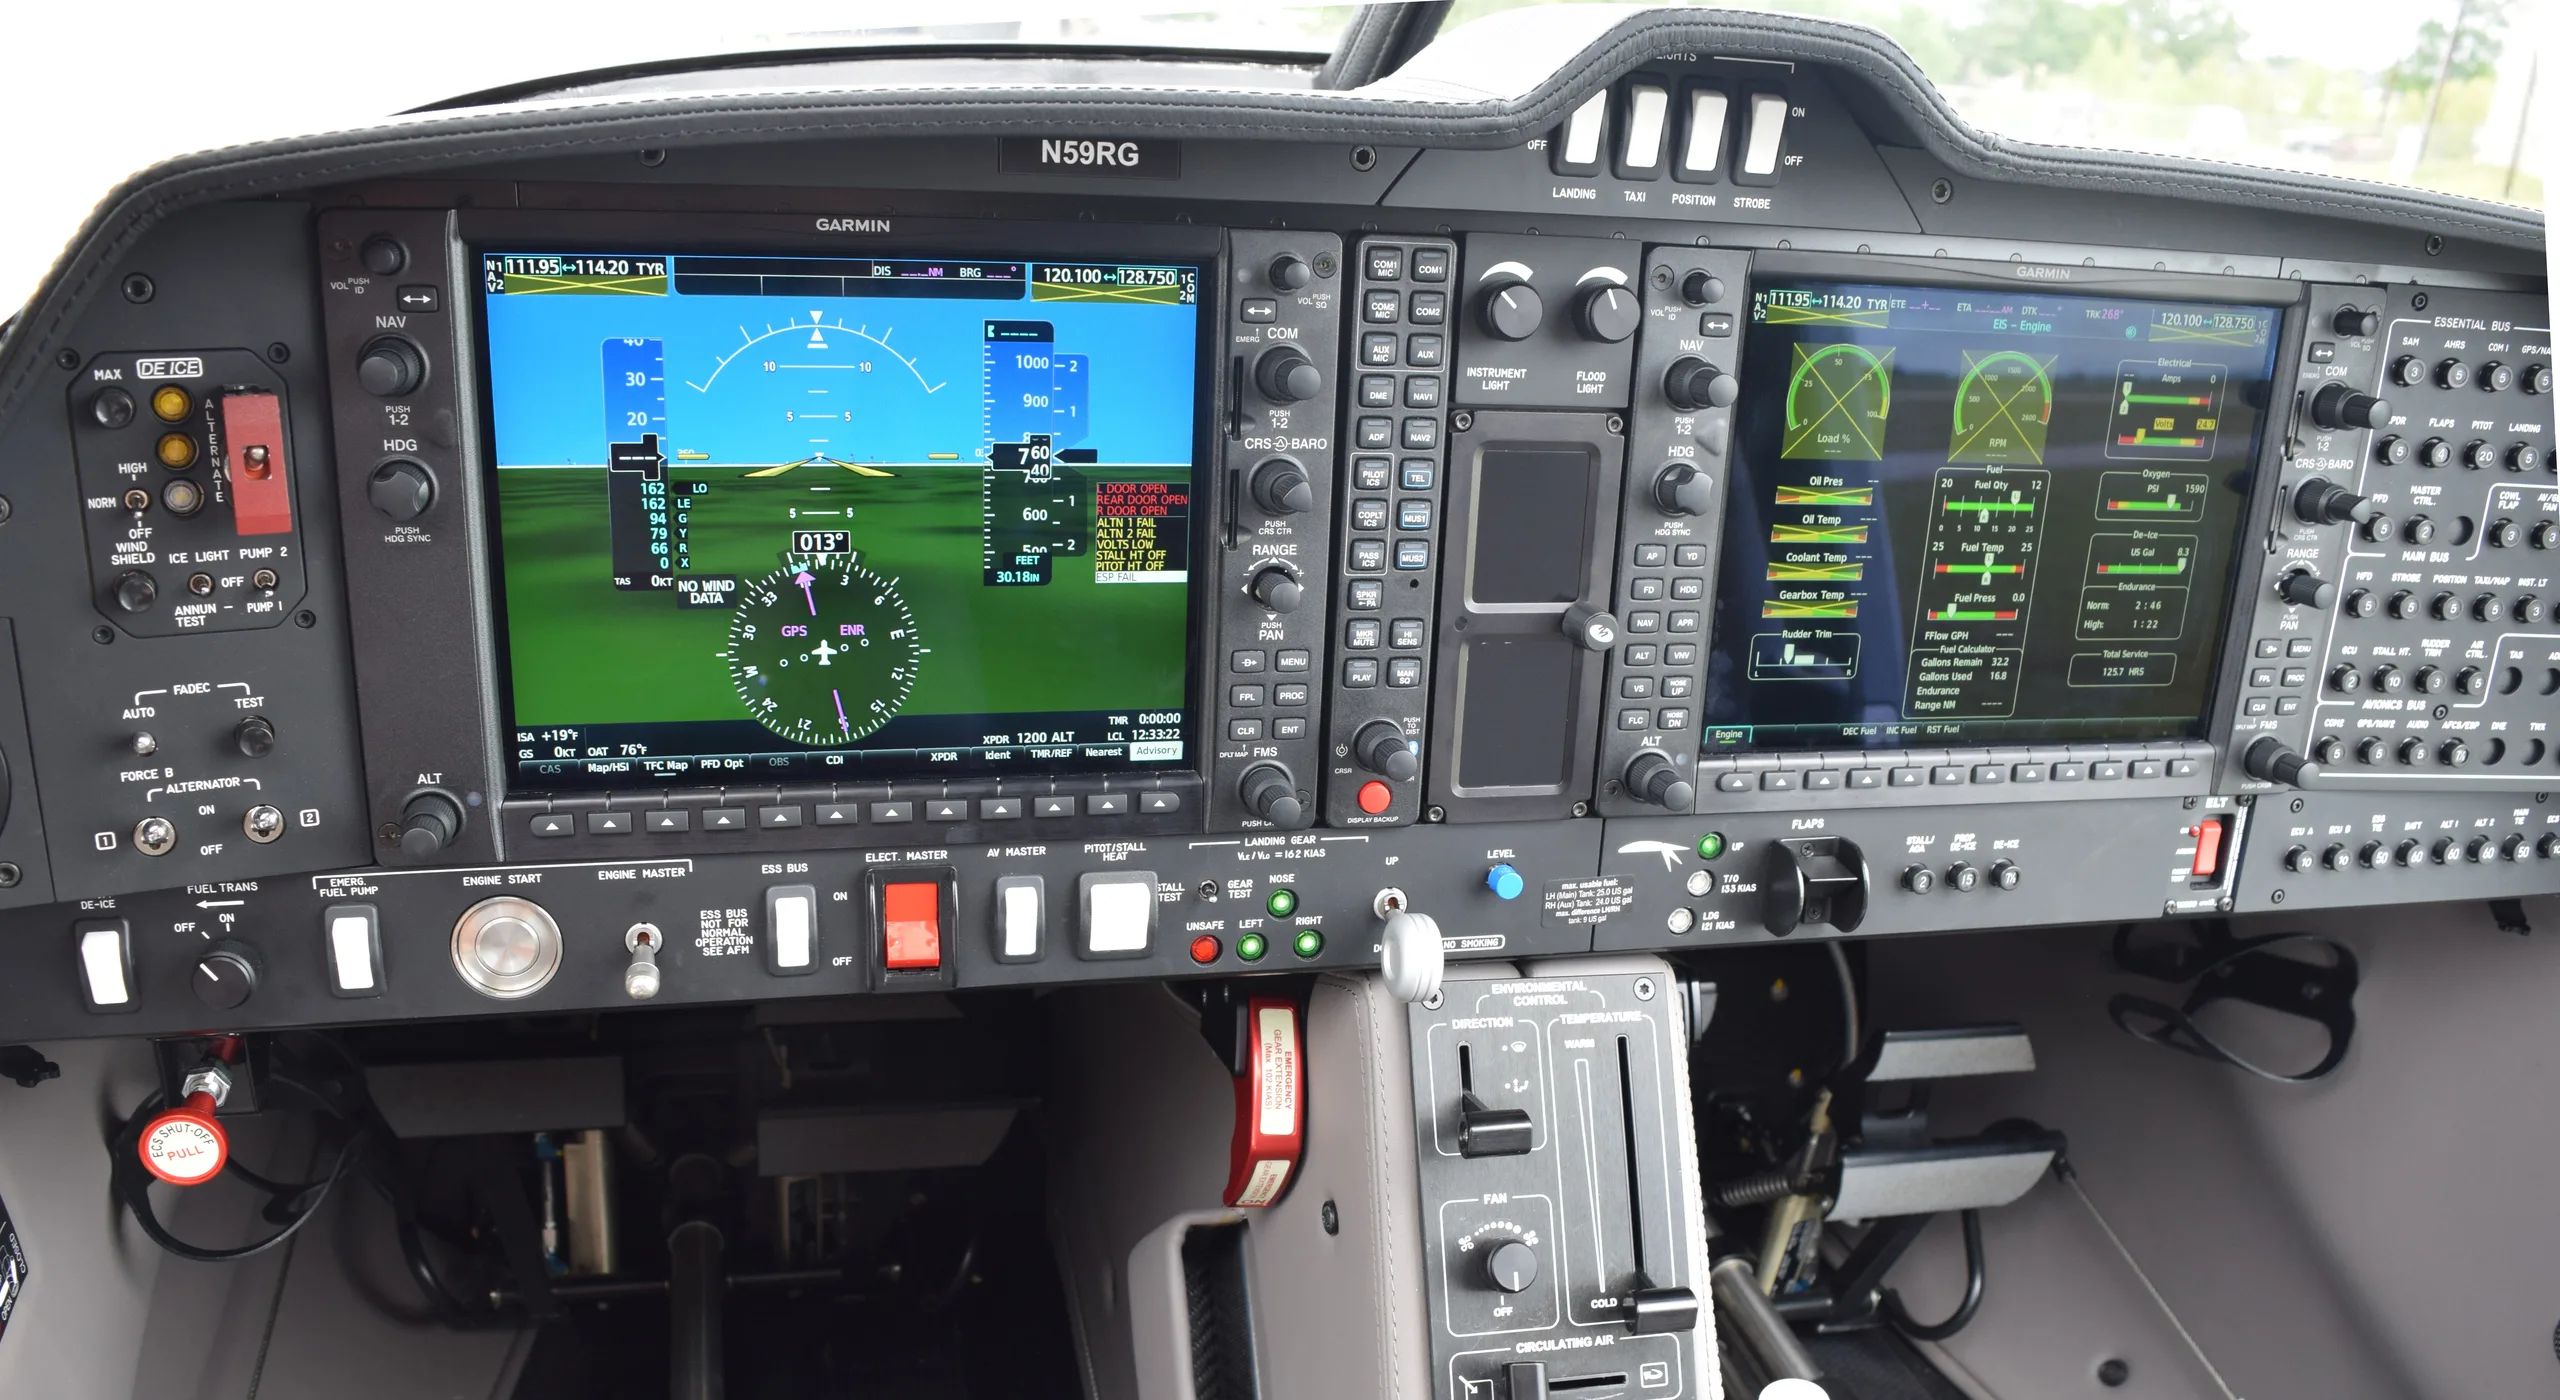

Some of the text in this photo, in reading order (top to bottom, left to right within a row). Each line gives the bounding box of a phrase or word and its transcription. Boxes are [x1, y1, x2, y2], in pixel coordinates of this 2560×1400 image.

[1527, 140, 1548, 151] OFF
[1041, 139, 1140, 167] N59RG
[1552, 187, 1771, 209] LANDING TAXI POSITION STROBE
[815, 218, 891, 233] GARMIN
[505, 258, 665, 276] 111.95 114.20 TYR
[959, 267, 982, 278] BRG
[1419, 266, 1442, 274] COM1
[2017, 266, 2070, 279] GARMIN
[1044, 268, 1176, 286] 120.100 128.750
[1771, 292, 1888, 310] 111.95 114.20 TYR
[1416, 308, 1440, 316] COM2
[375, 315, 407, 329] NAV
[2434, 317, 2511, 331] ESSENTIAL BUS
[1267, 328, 1298, 339] COM
[2402, 337, 2420, 346] SAM
[2444, 340, 2465, 349] AHRS
[1015, 355, 1049, 370] 1000
[2157, 357, 2192, 368] Electrical
[94, 369, 123, 381] MAX
[140, 362, 199, 376] DE ICE
[1466, 367, 1527, 379] INSTRUMENT
[1576, 371, 1606, 382] FLOOD
[1482, 380, 1510, 391] LIGHT
[1576, 383, 1604, 394] LIGHT
[1023, 394, 1049, 408] 900
[2429, 418, 2455, 428] FLAPS
[2472, 421, 2494, 430] PITOT
[1245, 438, 1327, 450] CRS BARO
[1817, 433, 1840, 443] Load
[383, 438, 418, 452] HDG
[118, 462, 147, 474] HIGH
[1810, 477, 1843, 486] Oil Pres
[1975, 480, 2008, 491] Fuel Qty
[2186, 484, 2205, 493] 1590
[88, 497, 117, 509] NORM
[641, 497, 666, 510] 162
[1097, 495, 1188, 505] REAR DOOR OPEN
[649, 512, 667, 525] 94
[1097, 517, 1157, 527] ALTN 1 FAIL
[650, 527, 668, 540] 79
[115, 542, 148, 553] WIND
[1097, 540, 1154, 550] VOLTS LOW
[1252, 545, 1297, 556] RANGE
[111, 552, 155, 565] SHIELD
[168, 547, 288, 564] ICE LIGHT PUMP 2
[1015, 555, 1040, 565] FEET
[1096, 550, 1166, 561] STALL HT OFF
[1786, 553, 1847, 564] Coolant Temp
[678, 579, 735, 592] NO WIND
[690, 592, 724, 605] DATA
[1779, 591, 1844, 601] Gearbox Temp
[174, 604, 217, 616] ANNUN
[175, 615, 207, 627] TEST
[781, 626, 807, 637] GPS
[840, 625, 865, 636] ENR
[1259, 630, 1284, 641] PAN
[1281, 658, 1306, 666] MENU
[1921, 658, 2009, 667] Gallons Remain 32.2
[173, 682, 211, 695] FADEC
[234, 696, 265, 709] TEST
[122, 707, 155, 720] AUTO
[1108, 713, 1181, 725] TMR 0:00:00
[983, 731, 1075, 745] XPDR 1200 ALT
[1107, 729, 1180, 741] LCL 12:33:22
[985, 750, 1011, 760] Ident
[1031, 748, 1072, 759] TMR/REF
[1085, 747, 1123, 757] Nearest
[1136, 745, 1178, 758] Advisory
[1253, 747, 1277, 757] FMS
[701, 758, 744, 770] PFD Opt
[826, 755, 843, 765] CDI
[588, 762, 630, 774] Map/HSI
[643, 761, 688, 773] TFC Map
[120, 768, 173, 782] FORCE B
[417, 773, 443, 785] ALT
[166, 777, 241, 794] ALTERNATOR
[1245, 835, 1316, 846] LANDING GEAR
[865, 850, 947, 862] ELECT. MASTER
[987, 846, 1046, 858] AV MASTER
[1487, 849, 1515, 859] LEVEL
[598, 868, 685, 880] ENGINE MASTER
[762, 863, 808, 874] ESS BUS
[330, 877, 367, 887] EMERG.
[463, 874, 542, 886] ENGINE START
[1269, 874, 1295, 884] NOSE
[187, 881, 259, 895] FUEL TRANS
[319, 885, 379, 897] FUEL PUMP
[1186, 921, 1224, 931] UNSAFE
[1239, 919, 1264, 929] LEFT
[1295, 916, 1322, 926] RIGHT
[1444, 938, 1498, 948] NO SMOKING
[1492, 980, 1587, 995] ENVIRONMENTAL
[1513, 994, 1568, 1006] CONTROL
[1560, 1010, 1642, 1025] TEMPERATURE
[159, 1123, 215, 1147] SHUT-OFF
[167, 1145, 204, 1161] PULL
[1484, 1193, 1507, 1204] FAN
[1591, 1298, 1618, 1309] COLD
[1516, 1334, 1614, 1354] CIRCULATING AIR
